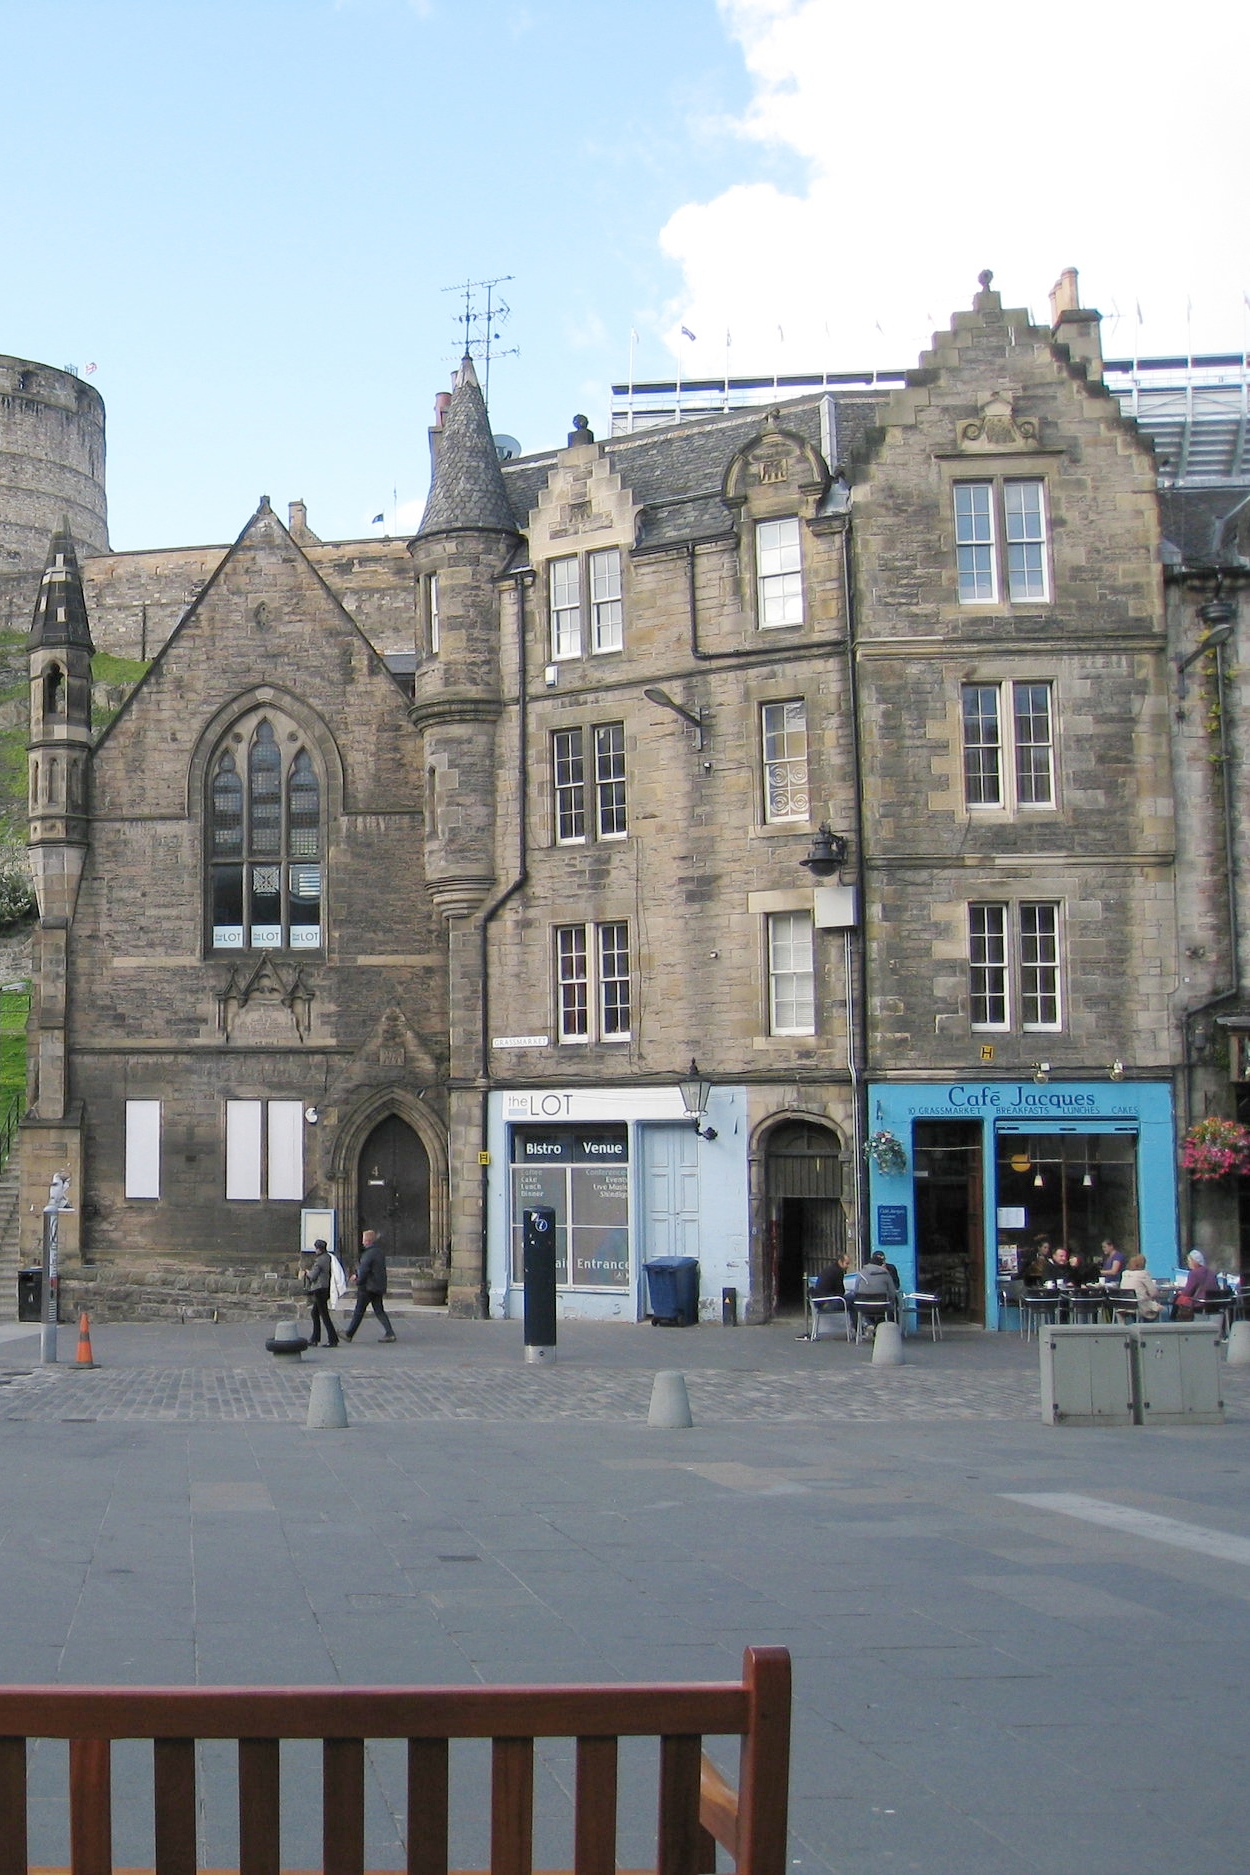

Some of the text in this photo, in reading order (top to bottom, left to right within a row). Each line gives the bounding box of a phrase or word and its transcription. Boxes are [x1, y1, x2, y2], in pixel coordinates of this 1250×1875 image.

[223, 933, 241, 942] LOT
[261, 932, 279, 941] LOT
[300, 932, 318, 941] LOT
[494, 1037, 547, 1047] GRASSMARKET
[981, 1047, 993, 1059] H
[948, 1086, 1095, 1109] Café Jacques
[508, 1094, 573, 1116] the LOT
[908, 1106, 1139, 1115] 10 GRASSMARKET BREAKFASTS LUNCHES CAKES
[526, 1143, 562, 1155] Bistro
[582, 1142, 623, 1154] Venue
[371, 1166, 379, 1177] 4
[585, 1168, 628, 1176] Conference
[599, 1190, 628, 1199] Shindig
[555, 1257, 568, 1269] ai
